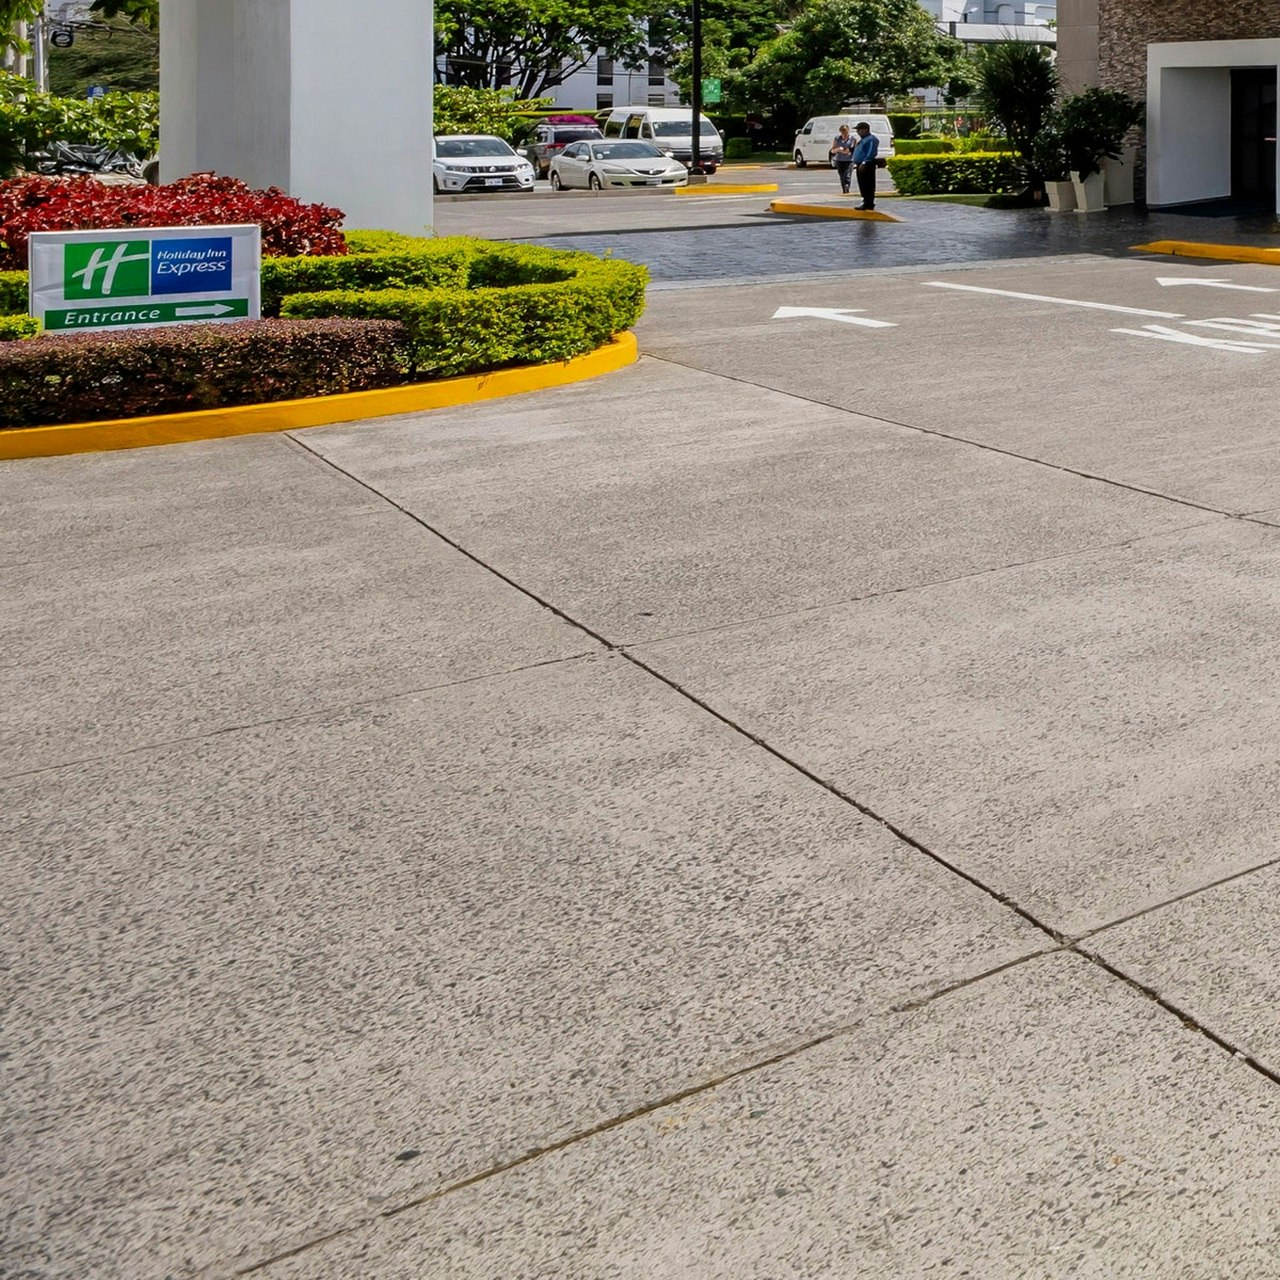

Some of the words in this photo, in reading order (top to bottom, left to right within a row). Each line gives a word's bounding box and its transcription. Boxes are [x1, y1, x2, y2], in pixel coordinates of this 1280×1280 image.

[157, 249, 206, 261] Holiday
[206, 248, 227, 258] Inn
[156, 260, 227, 276] Express
[64, 308, 161, 325] Entrance
